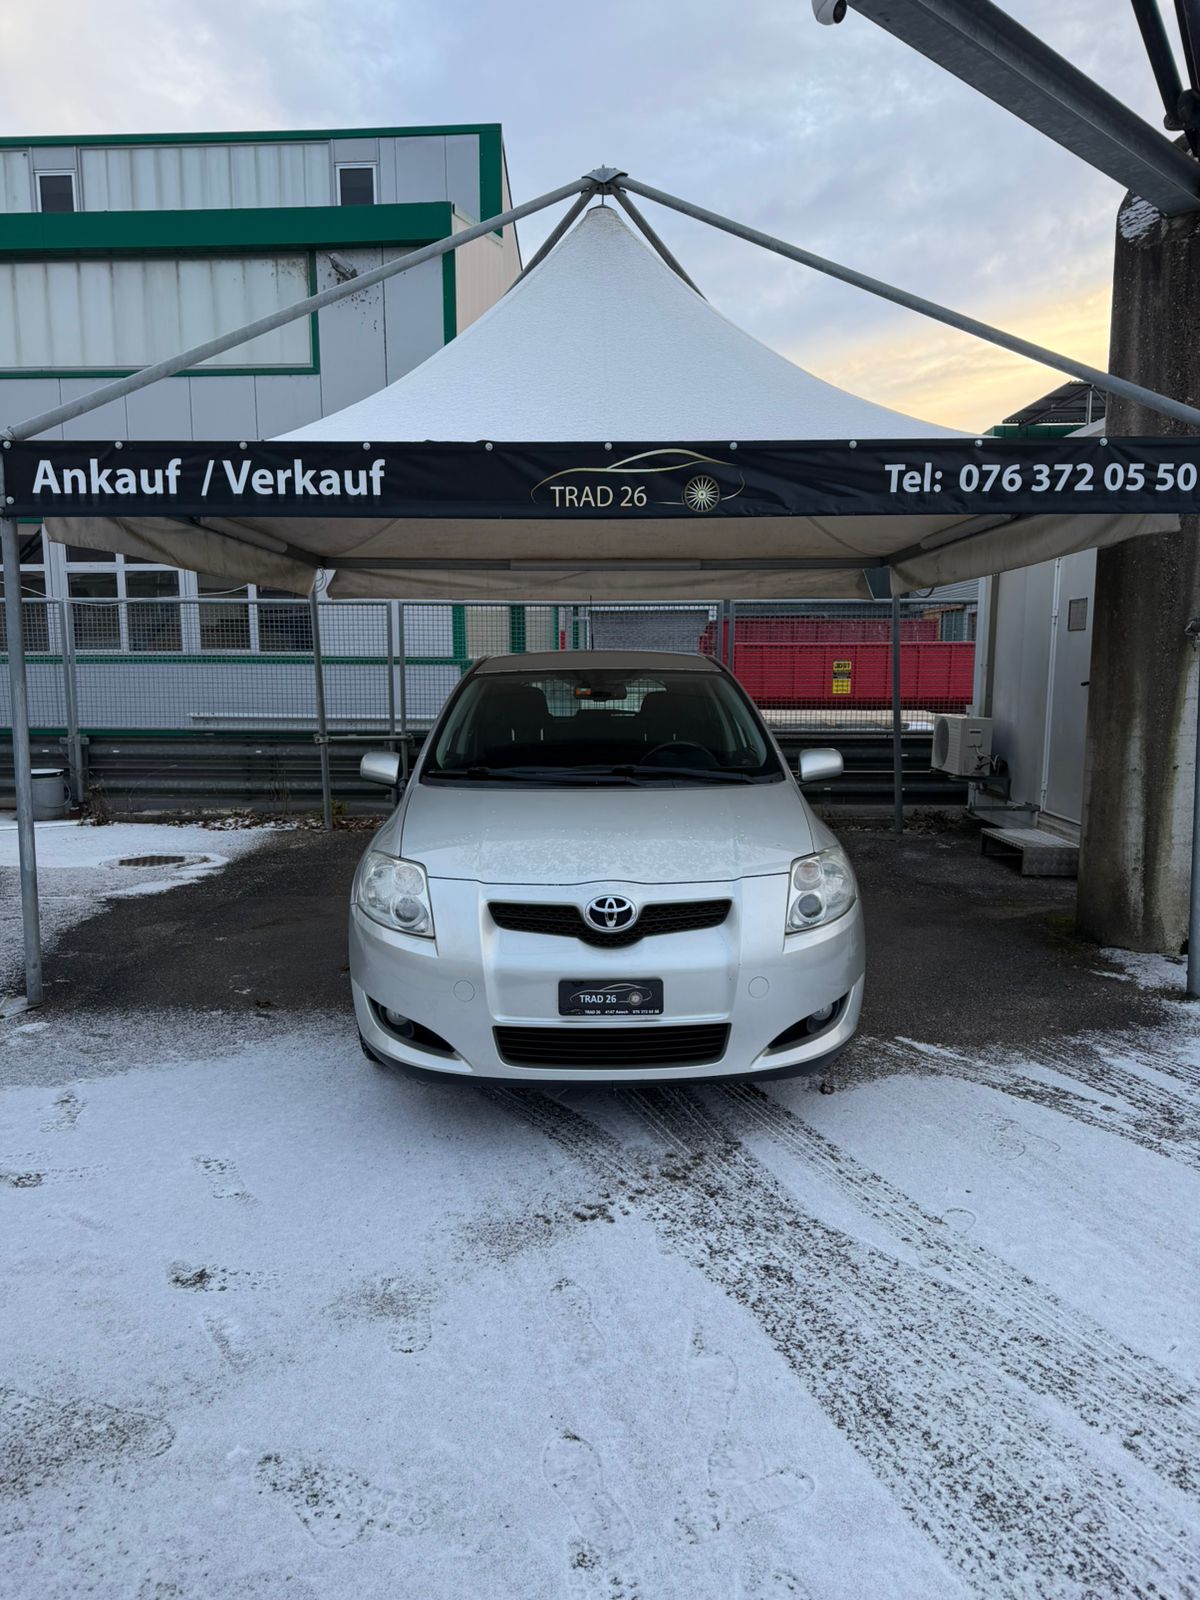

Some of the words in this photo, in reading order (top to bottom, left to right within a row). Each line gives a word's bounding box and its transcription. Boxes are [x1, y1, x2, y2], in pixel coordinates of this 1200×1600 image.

[33, 458, 181, 495] Ankauf
[222, 458, 386, 496] Verkauf
[885, 462, 941, 493] Tel:
[959, 463, 1022, 493] 076
[1030, 463, 1094, 492] 372
[1103, 462, 1145, 492] 05
[1154, 462, 1198, 492] 50
[550, 486, 613, 507] TRAD
[621, 486, 647, 507] 26
[579, 995, 604, 1003] TRAD
[606, 995, 617, 1003] 26
